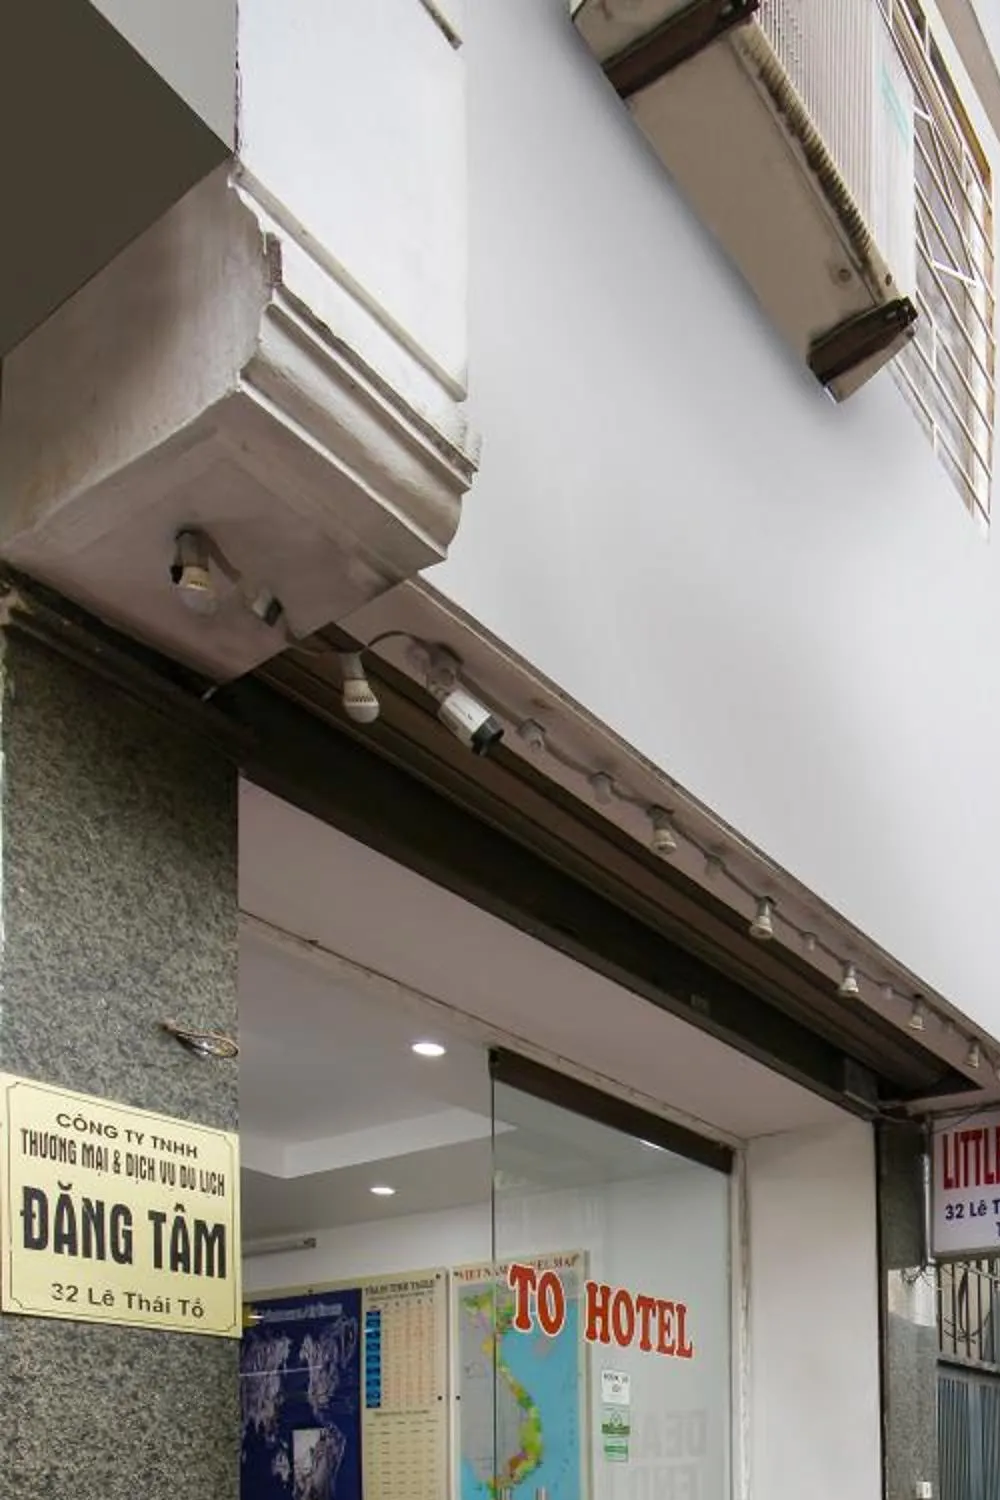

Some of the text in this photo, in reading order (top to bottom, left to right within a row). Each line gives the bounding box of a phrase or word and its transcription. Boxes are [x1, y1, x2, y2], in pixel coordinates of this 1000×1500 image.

[56, 1113, 198, 1159] CÔNG TY TNHH
[82, 1142, 108, 1176] MẠI
[112, 1149, 120, 1174] &
[126, 1152, 154, 1184] DỊCH
[180, 1165, 196, 1190] DU
[20, 1180, 227, 1279] ĐĂNG TÂM
[945, 1203, 964, 1221] 32
[969, 1199, 988, 1217] Lê
[51, 1283, 79, 1302] 32
[88, 1287, 115, 1306] Lê
[123, 1291, 170, 1314] Thái
[509, 1264, 693, 1359] TO HOTEL
